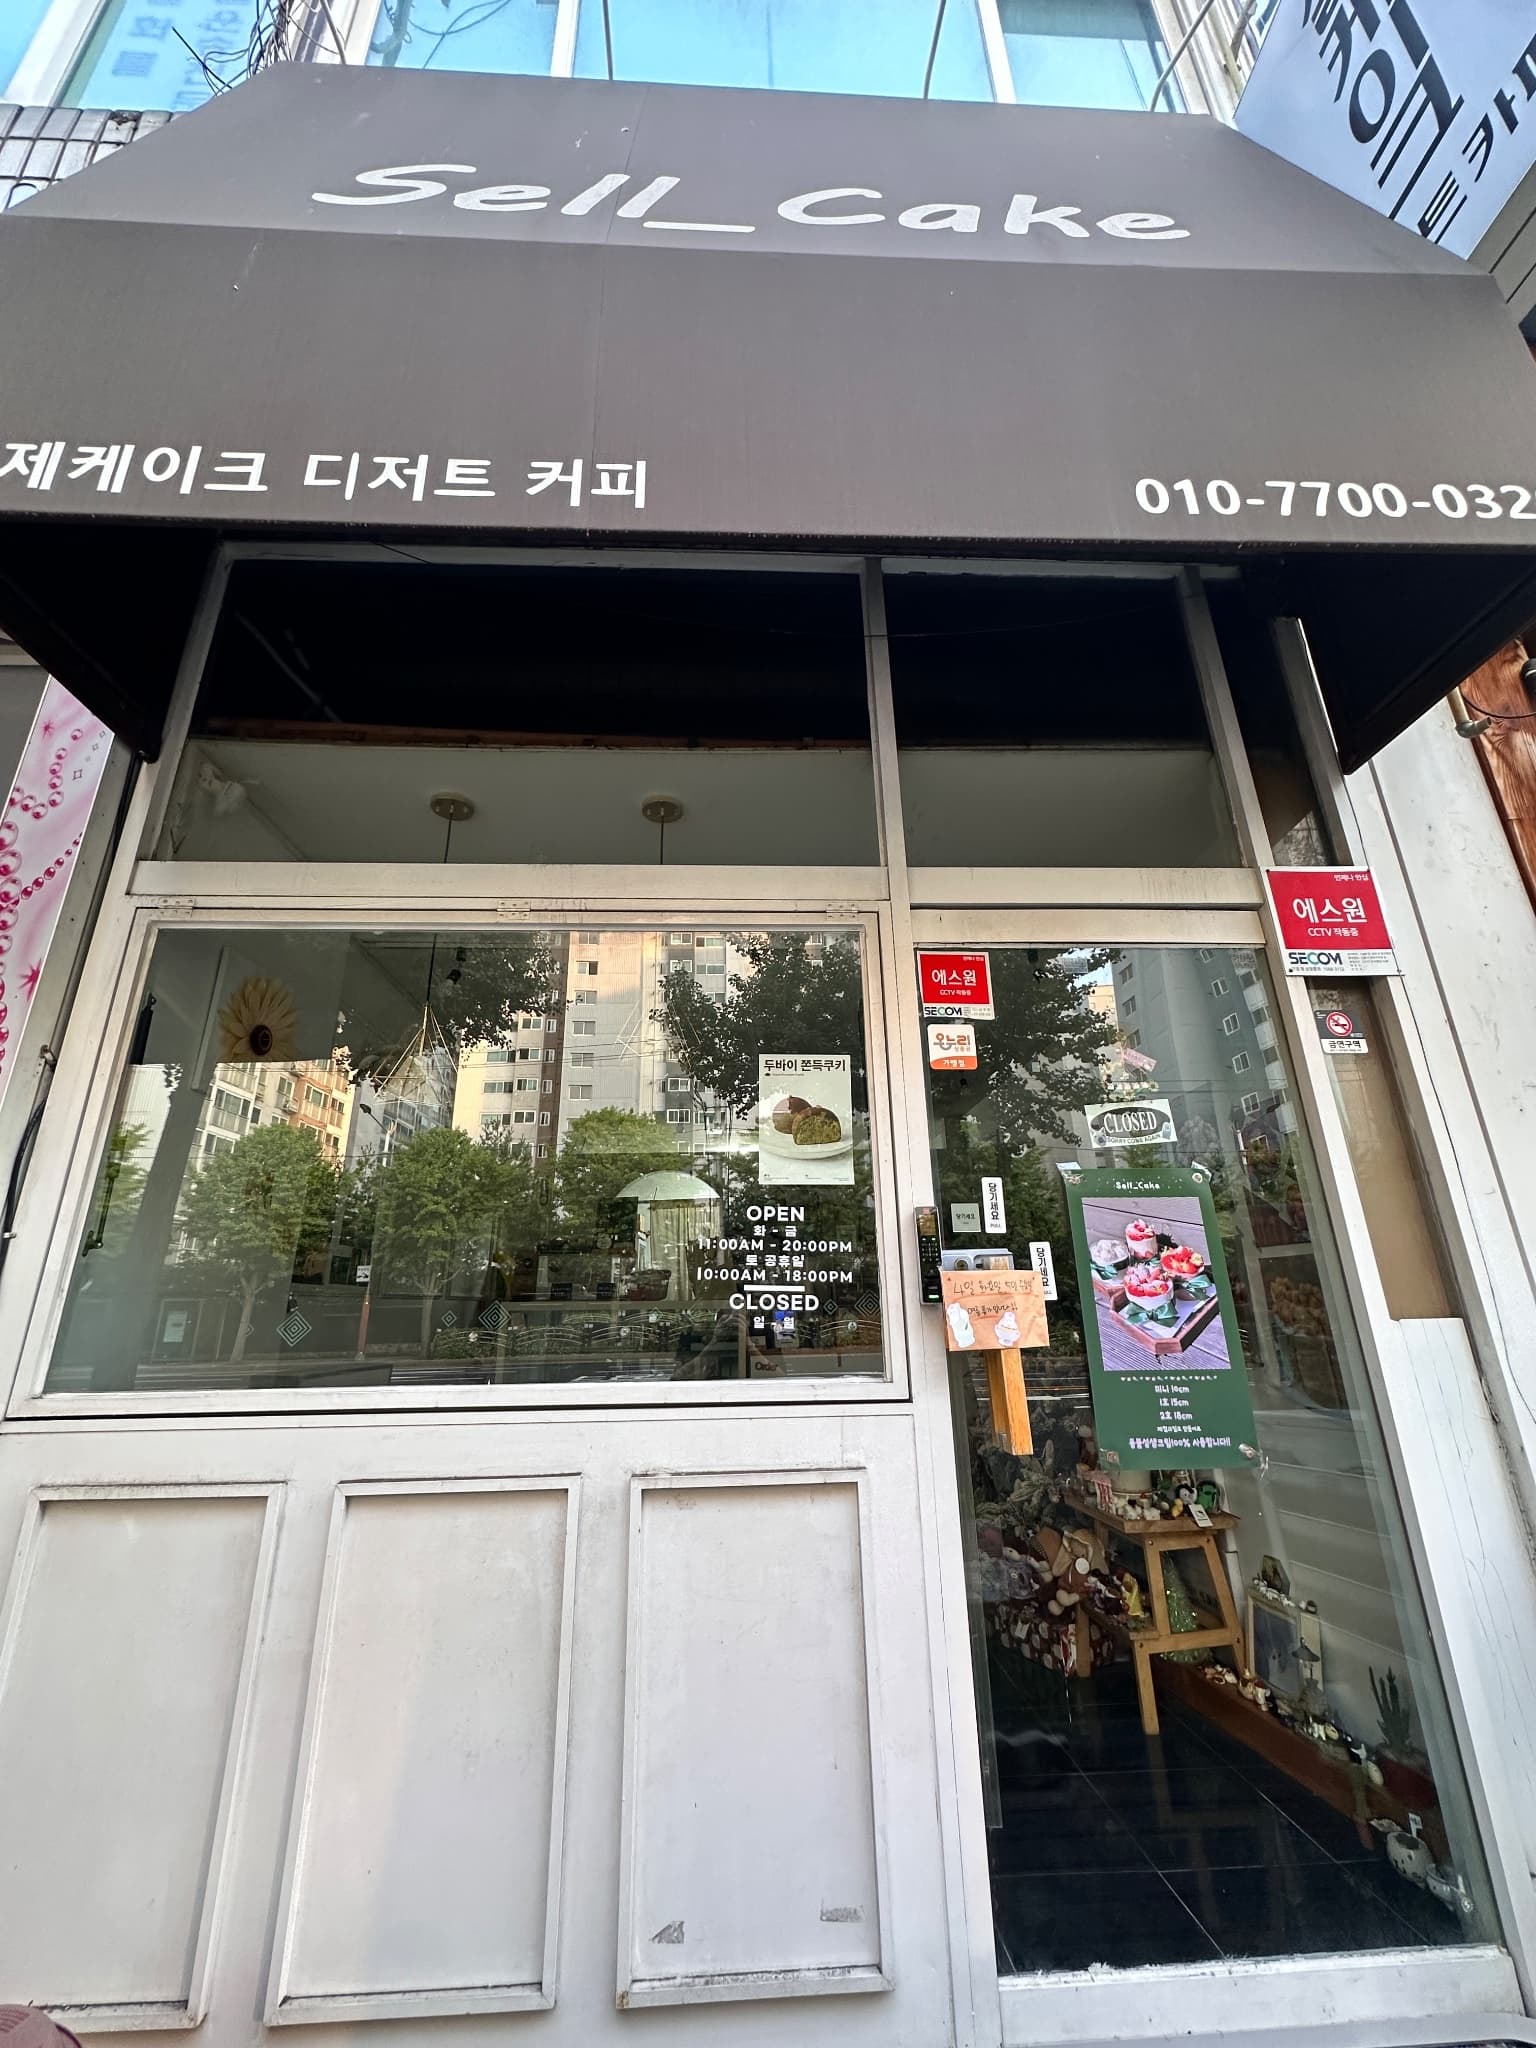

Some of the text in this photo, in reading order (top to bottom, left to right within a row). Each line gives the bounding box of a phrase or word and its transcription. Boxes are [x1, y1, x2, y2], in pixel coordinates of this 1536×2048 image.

[1302, 0, 1465, 220] 케이크
[1461, 32, 1536, 183] 카
[0, 441, 647, 509] 제케이크 디저트 커피
[1134, 477, 1536, 520] 010-7700-032
[1292, 897, 1368, 923] 에스원
[1308, 927, 1332, 937] CCTV
[1289, 952, 1343, 965] SECOM
[931, 969, 977, 986] 에스원
[924, 1006, 962, 1016] SECOM
[1328, 1040, 1362, 1049] 금연구역
[763, 1059, 846, 1072] 두바이 쫀득쿠키
[1103, 1110, 1158, 1134] CLOSED
[988, 1182, 1000, 1220] 당기세요
[746, 1205, 805, 1222] OPEN
[753, 1225, 766, 1237] 화
[784, 1225, 797, 1237] 금
[698, 1238, 764, 1251] 11:00AM
[782, 1240, 852, 1253] 20:00PM
[745, 1254, 805, 1268] 토 공휴일
[697, 1267, 766, 1281] 10:00AM
[784, 1269, 853, 1283] 18:00PM
[729, 1293, 819, 1311] CLOSED
[753, 1316, 765, 1329] 일
[783, 1316, 795, 1329] 월
[1154, 1384, 1190, 1394] 미니 10cm
[1159, 1397, 1190, 1407] 1호 15cm
[1159, 1411, 1193, 1420] 2호 18cm
